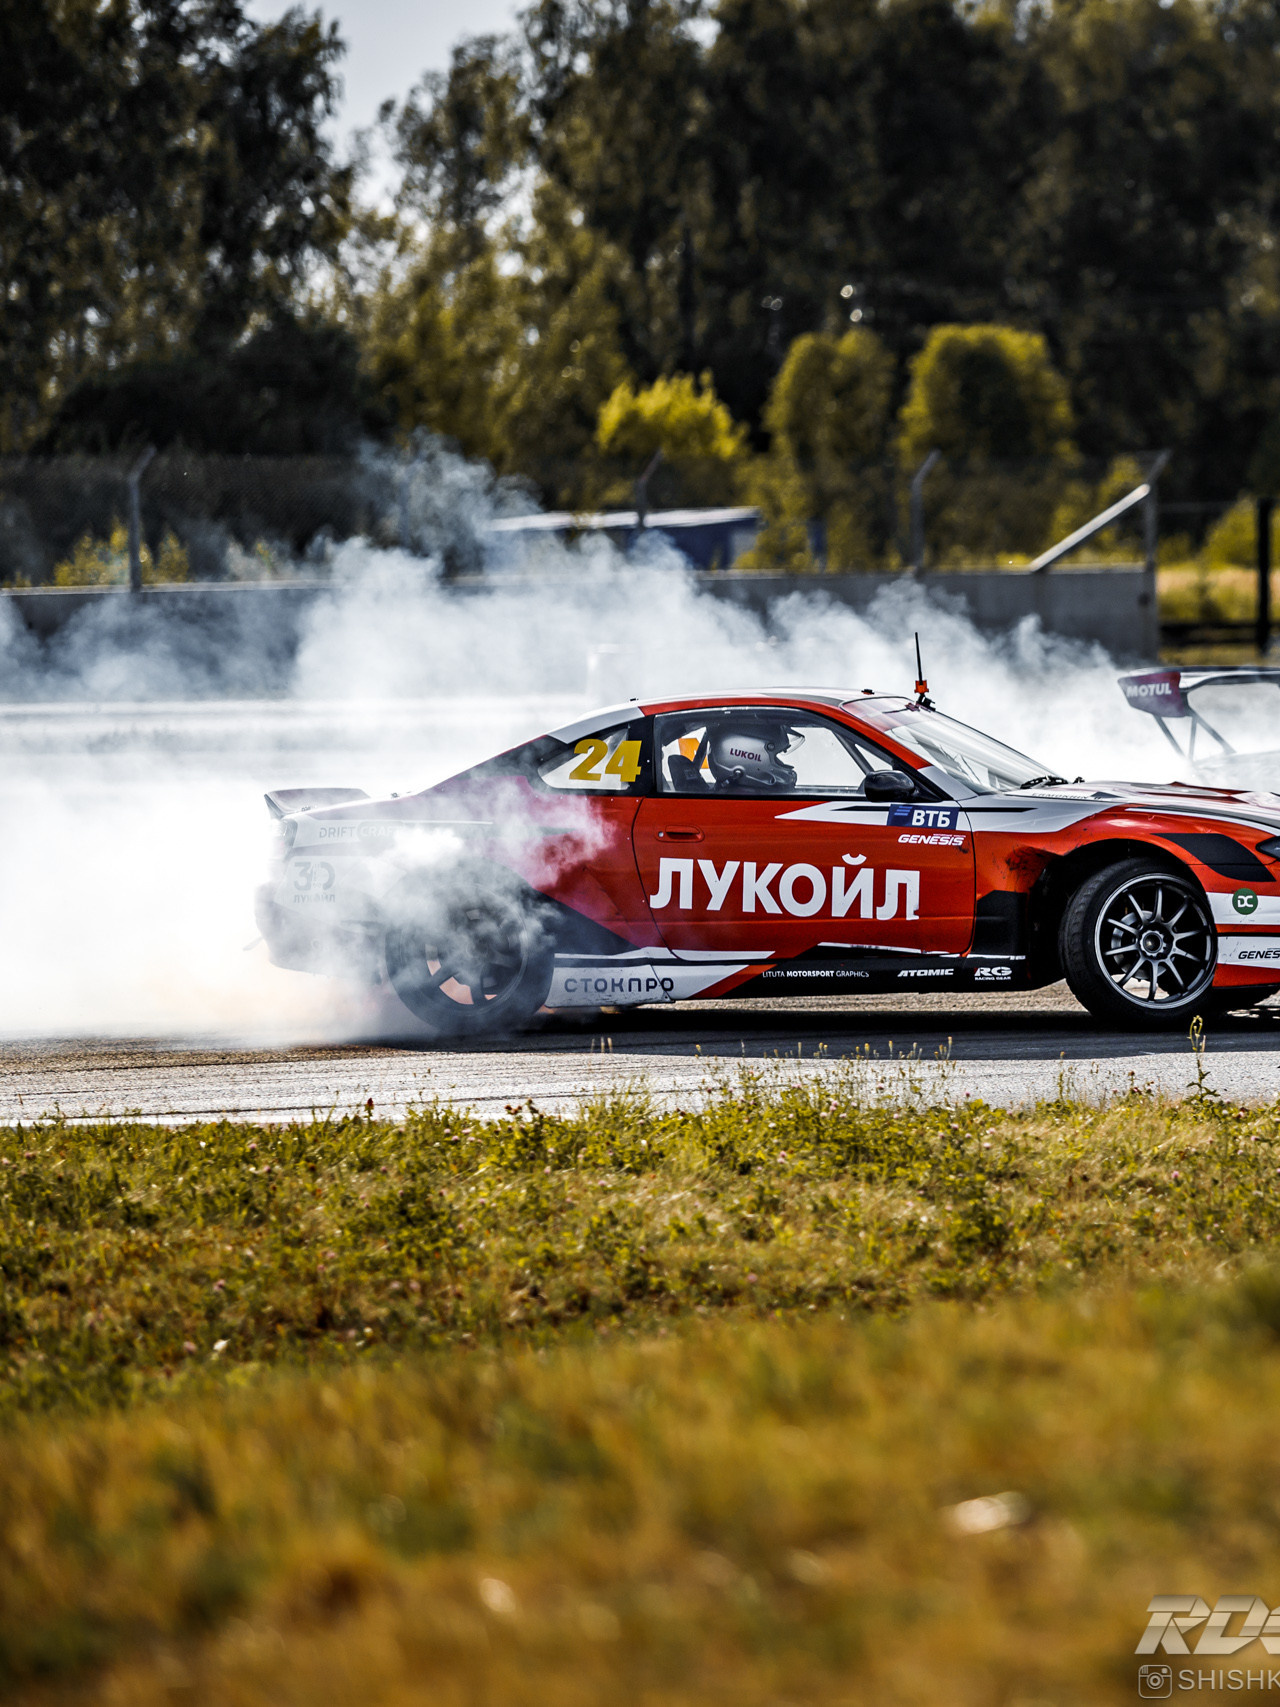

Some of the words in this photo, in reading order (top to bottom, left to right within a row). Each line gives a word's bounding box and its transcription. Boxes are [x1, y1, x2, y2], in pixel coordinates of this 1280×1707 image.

[1126, 683, 1172, 697] MOTUL
[568, 738, 642, 783] 24
[729, 747, 762, 762] LUKOIL
[911, 809, 951, 828] ВТБ
[319, 827, 356, 839] DRIFT
[897, 834, 965, 846] GENESIS
[649, 853, 921, 921] ЛУКОЙЛ
[786, 970, 835, 978] MOTORSPORT
[835, 970, 870, 978] GRAPHICS
[897, 968, 955, 978] ATOMIC
[974, 966, 1013, 977] RG
[564, 976, 675, 993] СТОКПРО
